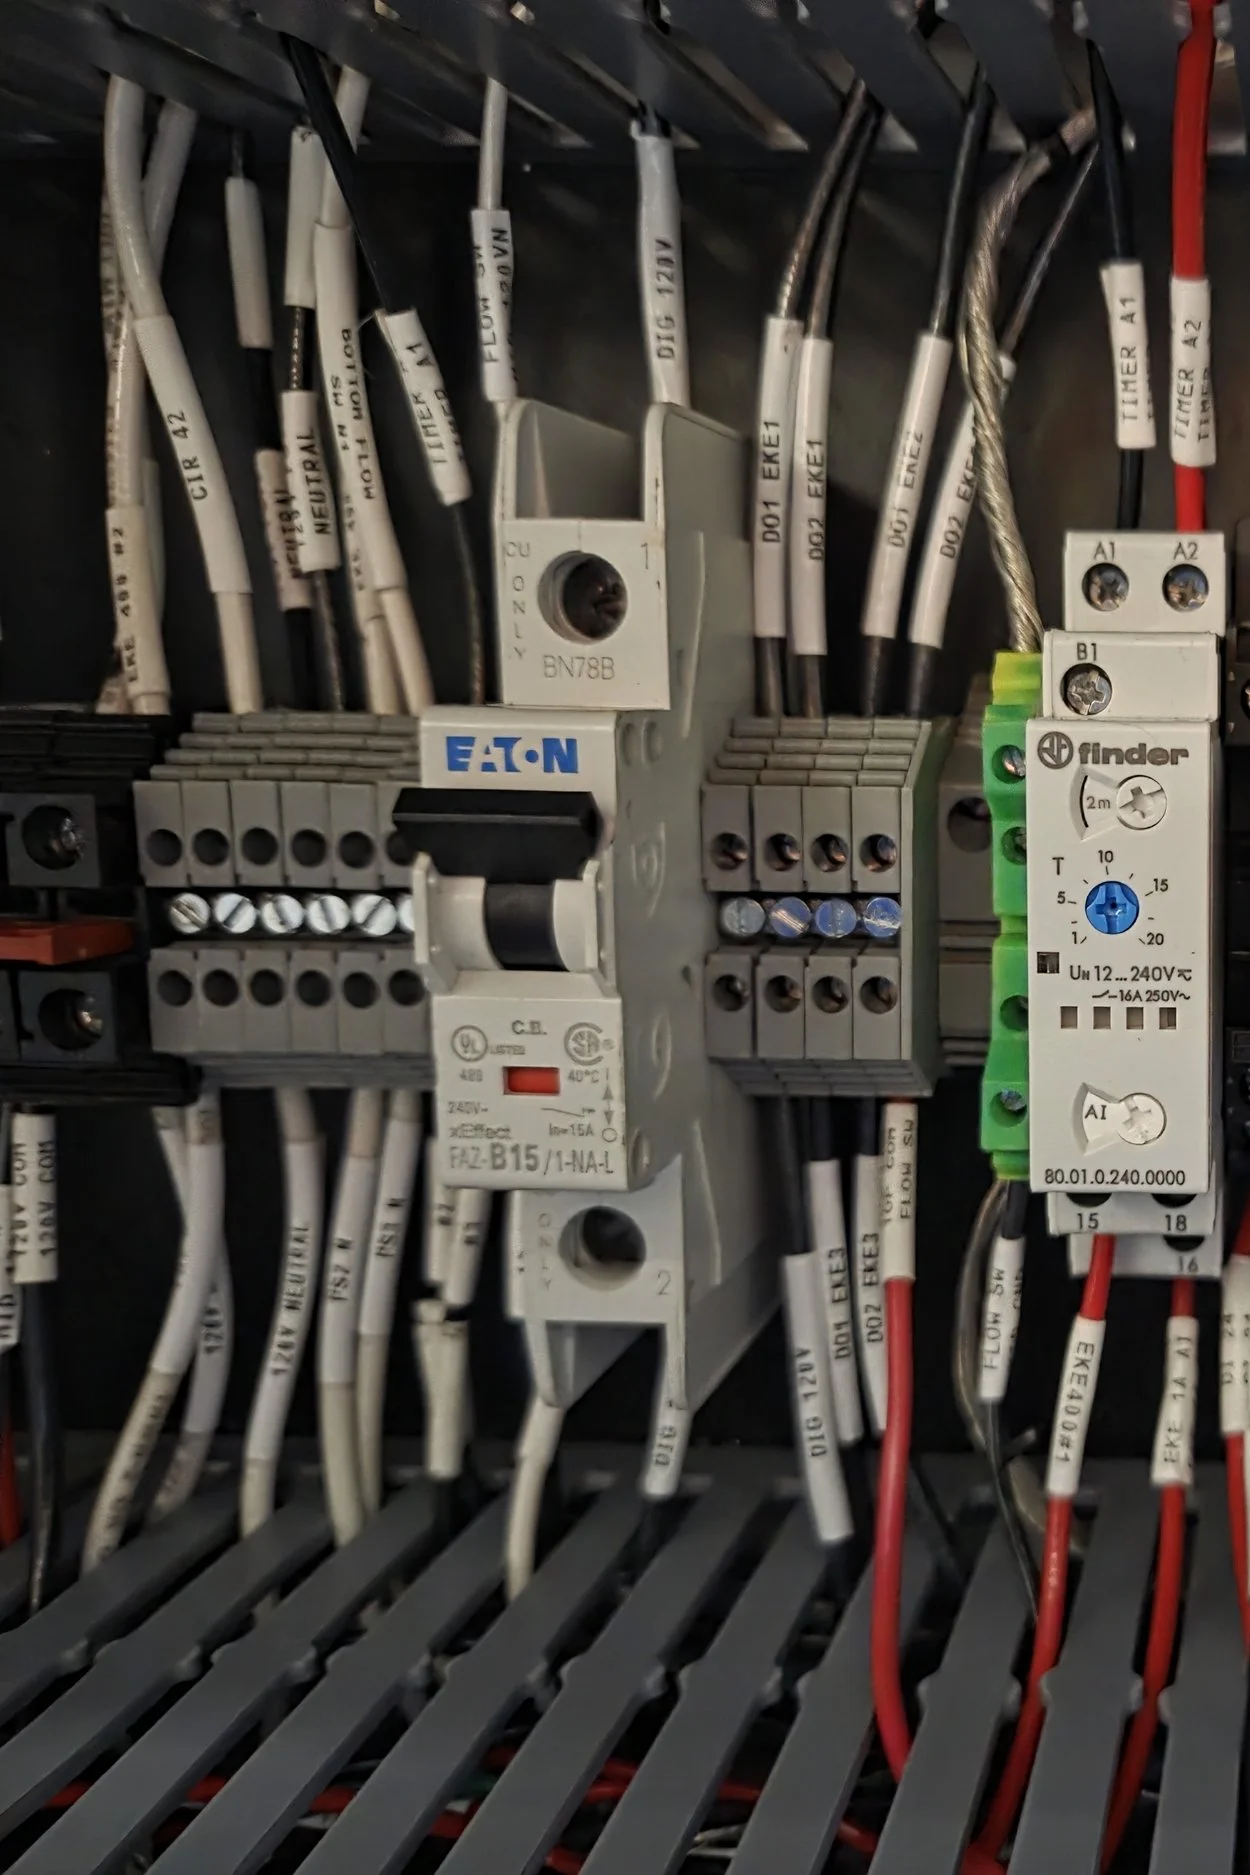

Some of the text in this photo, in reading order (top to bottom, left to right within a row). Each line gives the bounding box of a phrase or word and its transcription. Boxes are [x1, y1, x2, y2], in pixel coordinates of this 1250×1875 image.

[655, 237, 675, 360] DIG 120V
[479, 298, 498, 363] FLOW
[405, 341, 434, 370] A1
[1119, 297, 1138, 420] TIMER A1
[1174, 319, 1201, 439] TIMER A2
[341, 328, 376, 500] BOTTOM FLOW
[167, 409, 208, 501] CIR 42
[762, 420, 780, 481] EKE1
[296, 429, 331, 535] NEUTRAL
[806, 439, 824, 498] EKE1
[640, 542, 649, 570] 1
[1093, 541, 1116, 560] A1
[1172, 541, 1199, 560] A2
[1076, 642, 1097, 661] B1
[543, 654, 615, 680] BN78B
[445, 736, 579, 774] EATON
[1078, 743, 1189, 766] finder
[1086, 795, 1111, 809] 2m
[1052, 856, 1064, 875] T
[1098, 850, 1114, 863] 10
[1057, 891, 1066, 904] 5
[1153, 878, 1169, 892] 15
[1071, 931, 1078, 944] 1
[1146, 932, 1165, 945] 20
[1085, 1104, 1107, 1120] AI
[38, 1140, 55, 1183] COM
[450, 1142, 614, 1175] FAZ-B15/1-NA-L
[900, 1119, 914, 1219] FLOW SW
[1044, 1168, 1186, 1186] 80.01.0.240.0000
[1077, 1212, 1099, 1230] 15
[1165, 1214, 1187, 1232] 18
[284, 1226, 309, 1310] NEUTRAL
[862, 1232, 880, 1287] EKE3
[1178, 1256, 1198, 1273] 16
[657, 1269, 672, 1296] 2
[828, 1248, 848, 1304] EKE3
[983, 1267, 1004, 1370] FLOW SW
[796, 1347, 827, 1457] DIG 120V
[1056, 1341, 1095, 1463] EKE400#1
